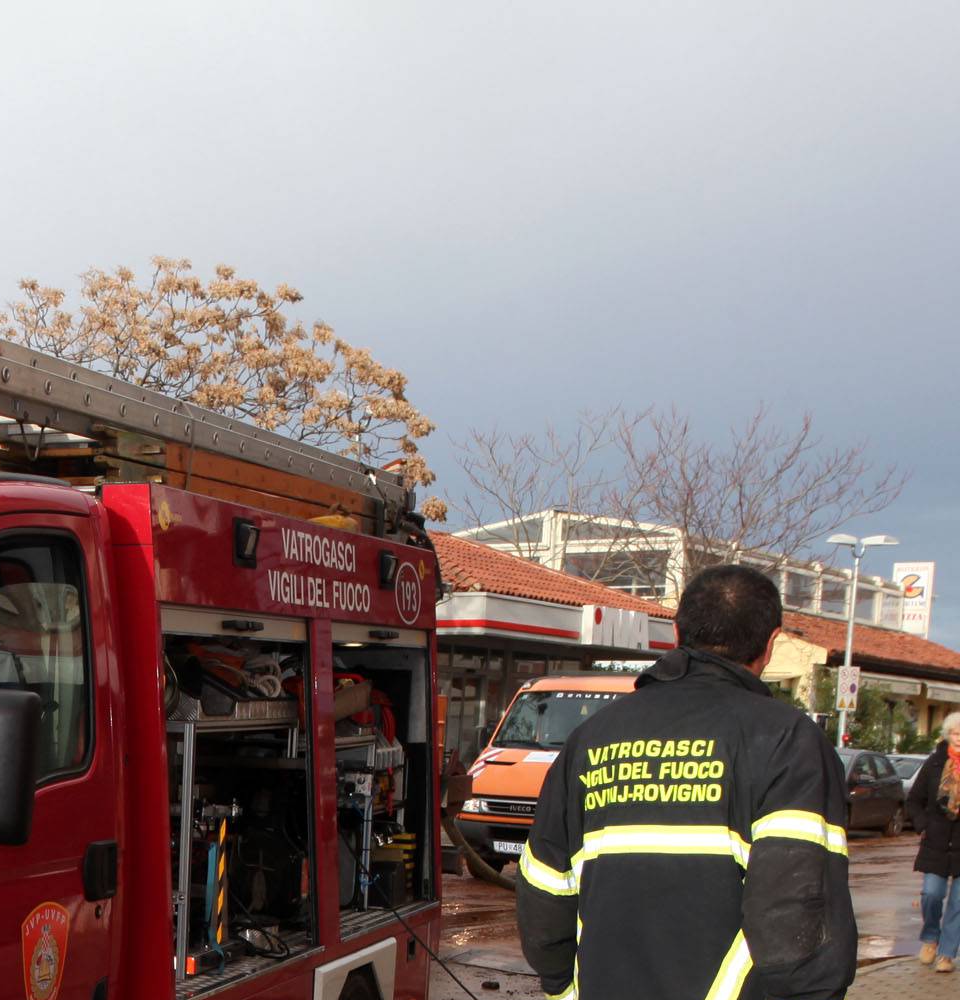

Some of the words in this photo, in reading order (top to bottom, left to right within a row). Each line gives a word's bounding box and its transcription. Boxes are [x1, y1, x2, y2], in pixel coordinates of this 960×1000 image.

[281, 528, 356, 573] VATROGASCI
[268, 569, 305, 606] VIGILI
[307, 576, 330, 609] DEL
[333, 580, 371, 613] FUOCO
[401, 581, 417, 612] 193
[588, 739, 715, 766] VATROGASCI
[618, 762, 652, 781] DEL
[658, 760, 724, 780] FUOCO
